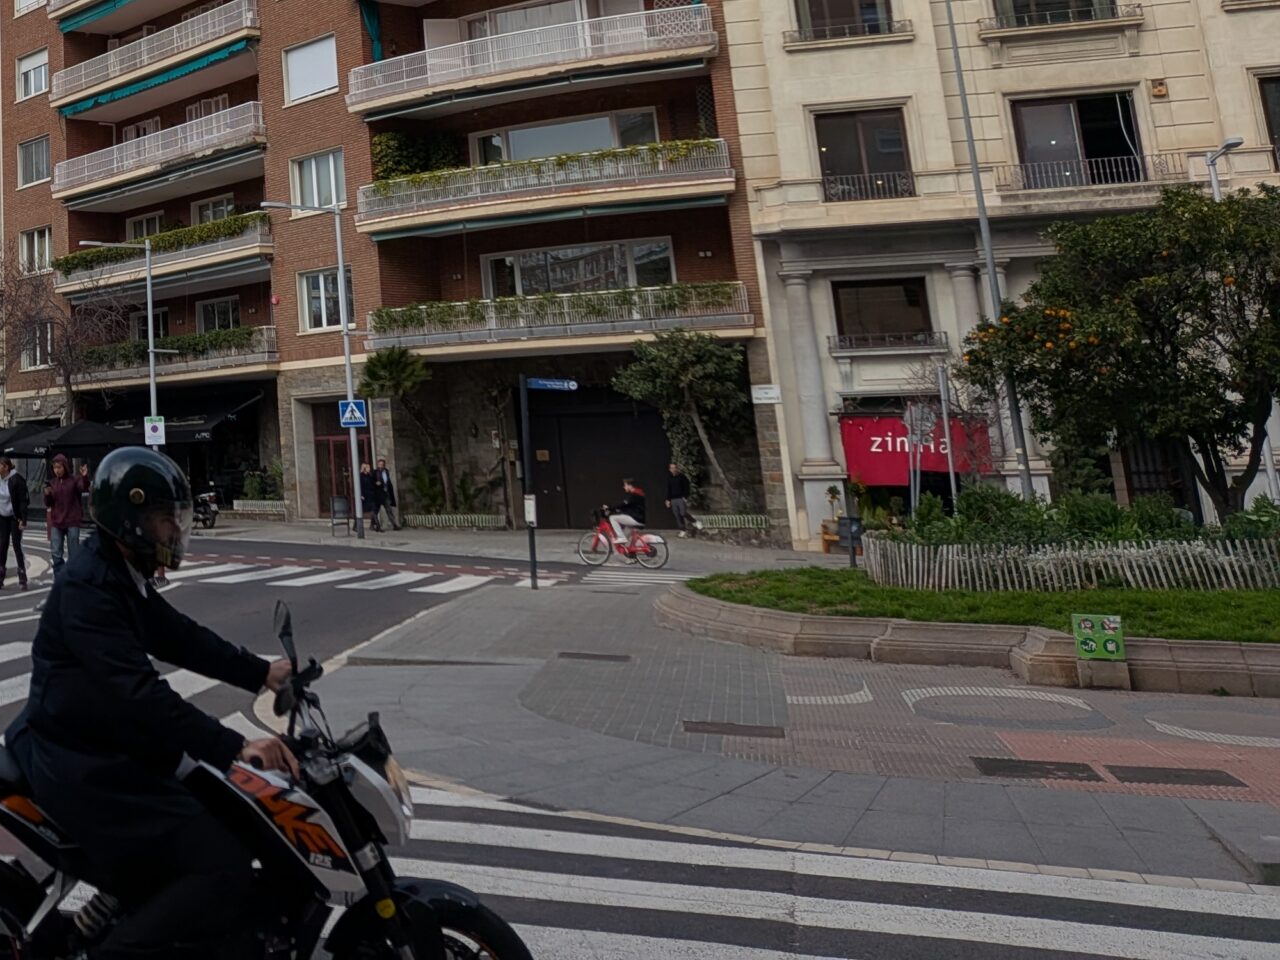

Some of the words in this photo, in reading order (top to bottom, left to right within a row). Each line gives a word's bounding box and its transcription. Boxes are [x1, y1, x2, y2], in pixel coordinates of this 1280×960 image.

[870, 432, 950, 454] zinia
[228, 762, 347, 859] DUKE
[309, 851, 333, 869] 125
